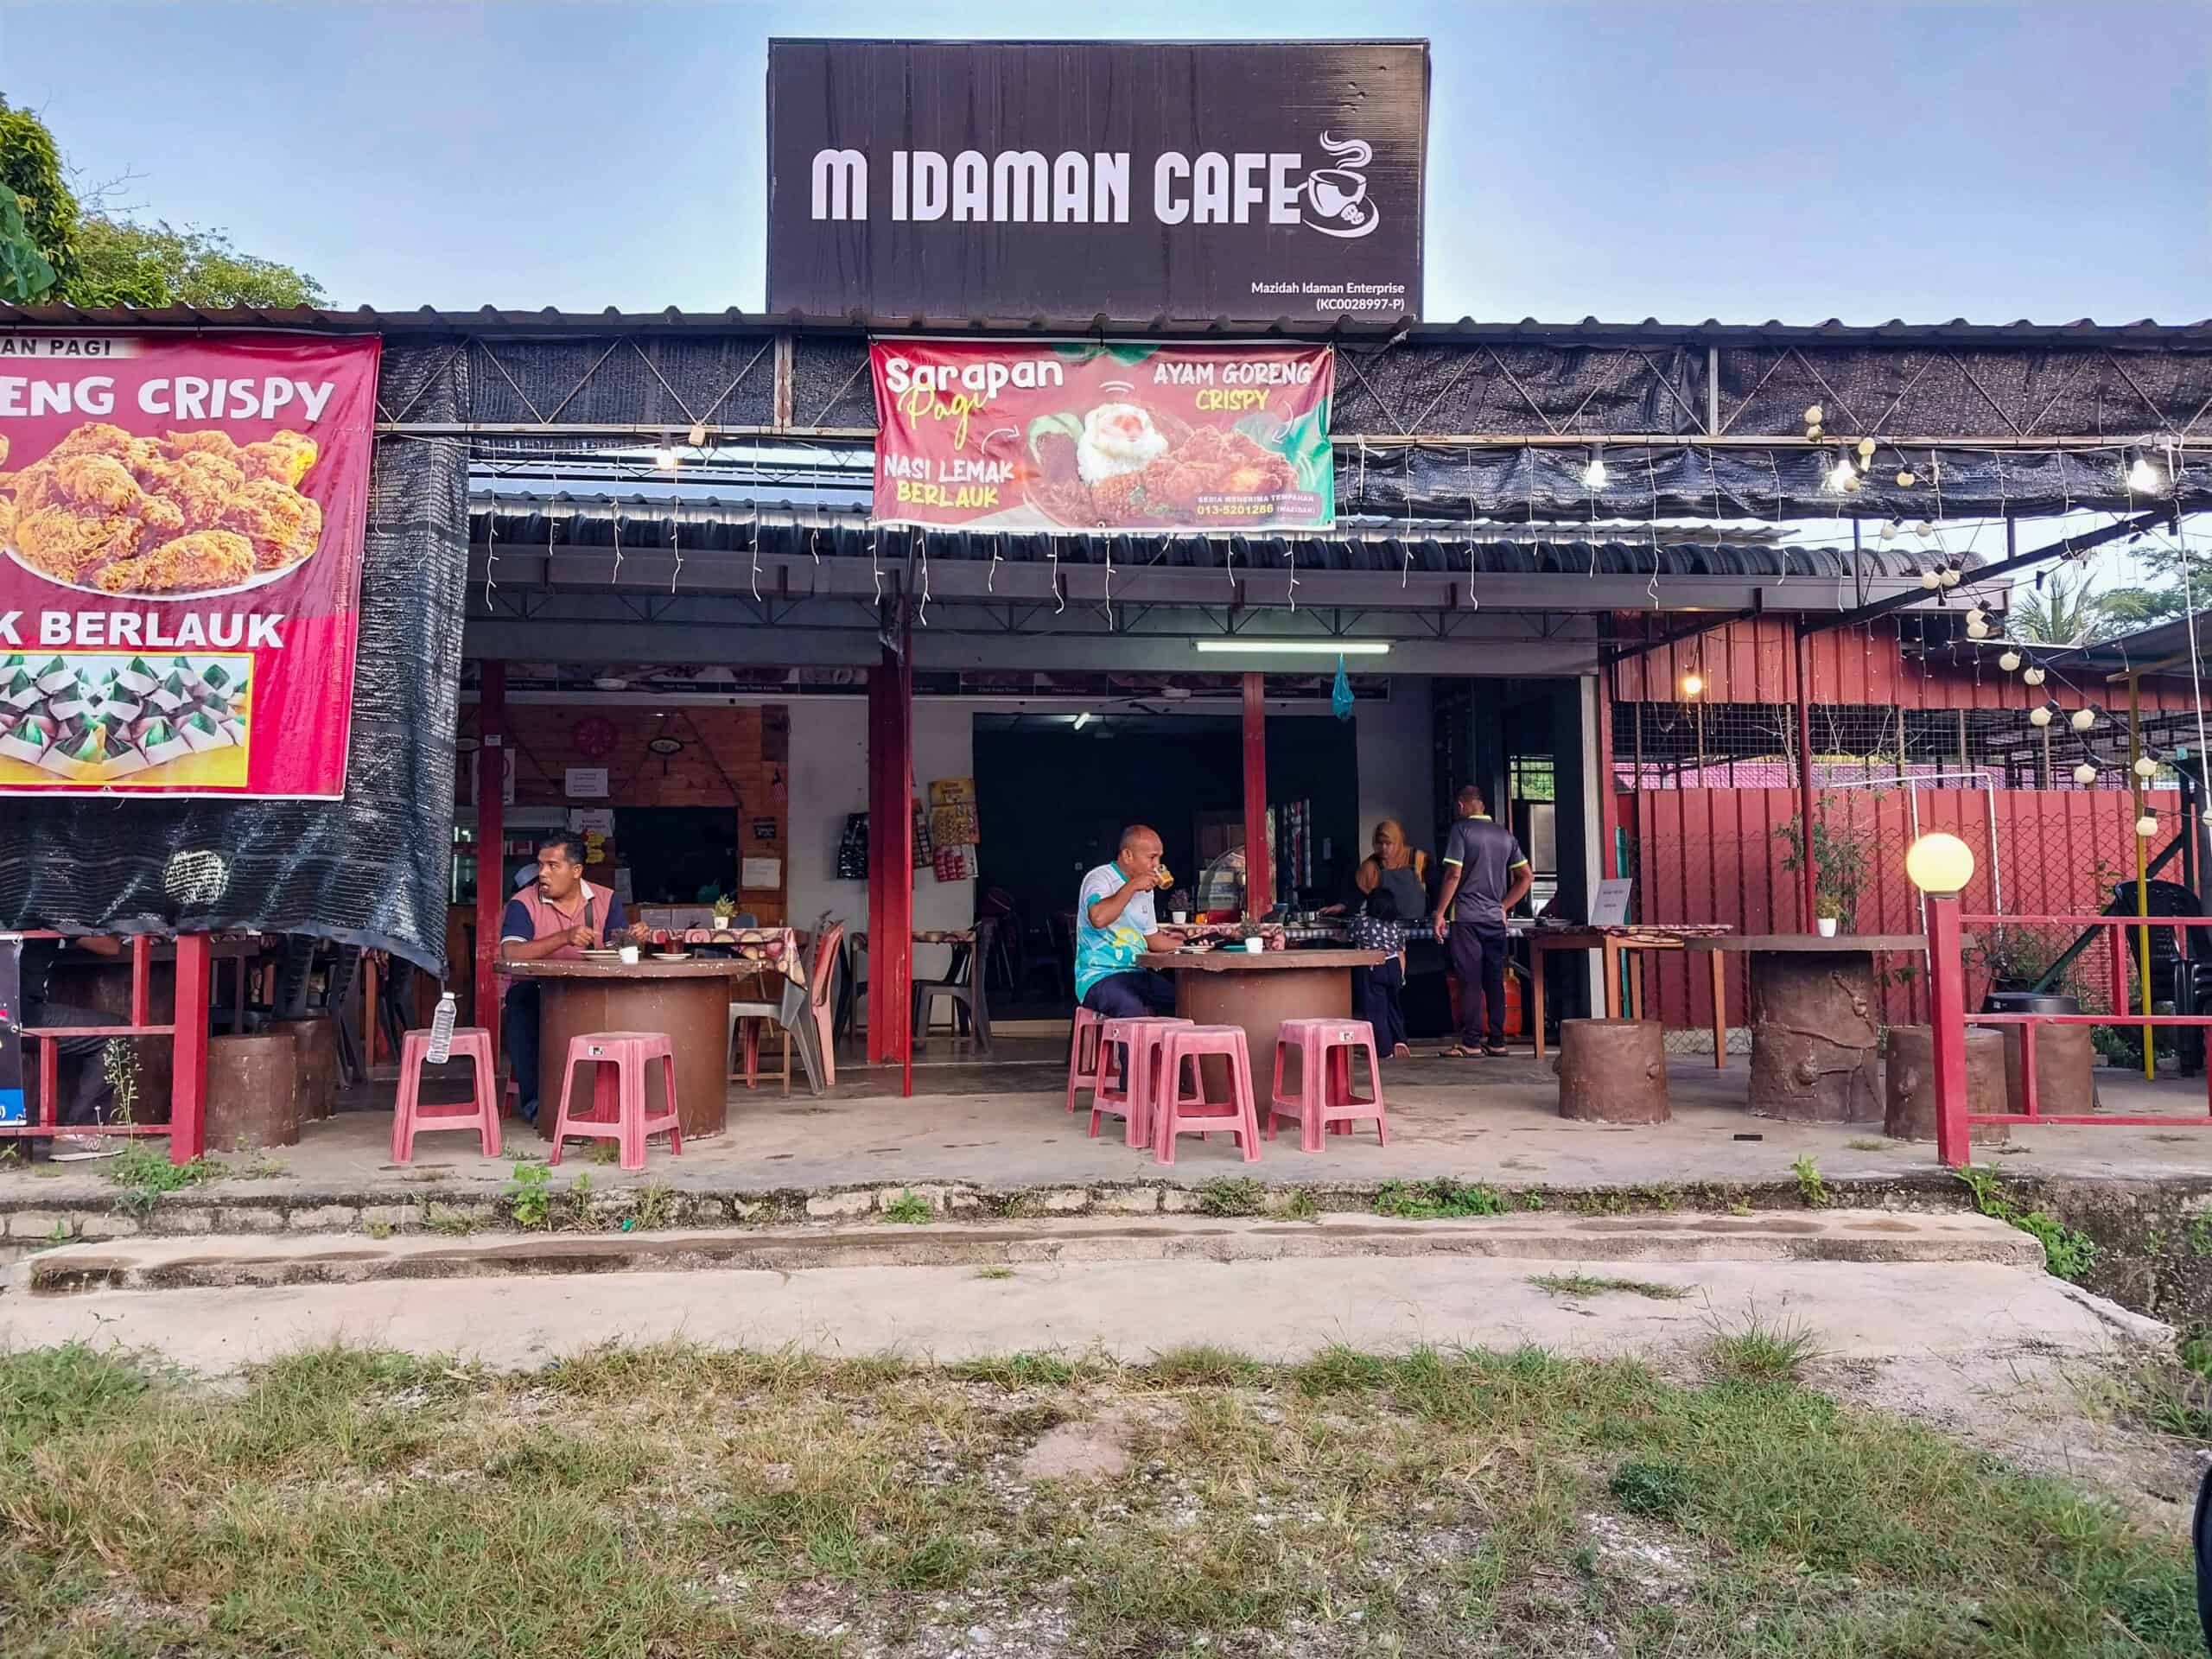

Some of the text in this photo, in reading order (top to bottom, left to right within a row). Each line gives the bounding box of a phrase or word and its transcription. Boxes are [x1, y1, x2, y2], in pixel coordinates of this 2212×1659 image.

[810, 149, 1302, 226] M IDAMAN CAFE
[1251, 282, 1405, 296] Mazidah Idaman Enterprise
[1316, 298, 1405, 311] (KC0028997-P)
[50, 339, 111, 356] PAGI
[886, 357, 1064, 400] Sarapan
[1154, 362, 1313, 386] AYAM GORENG
[137, 375, 335, 422] CRISPY
[1195, 389, 1270, 411] CRISPY
[898, 383, 991, 451] Pagi
[885, 454, 1014, 484] NASI LEMAK
[896, 481, 999, 508] BERLAUK
[40, 611, 284, 649] BERLAUK
